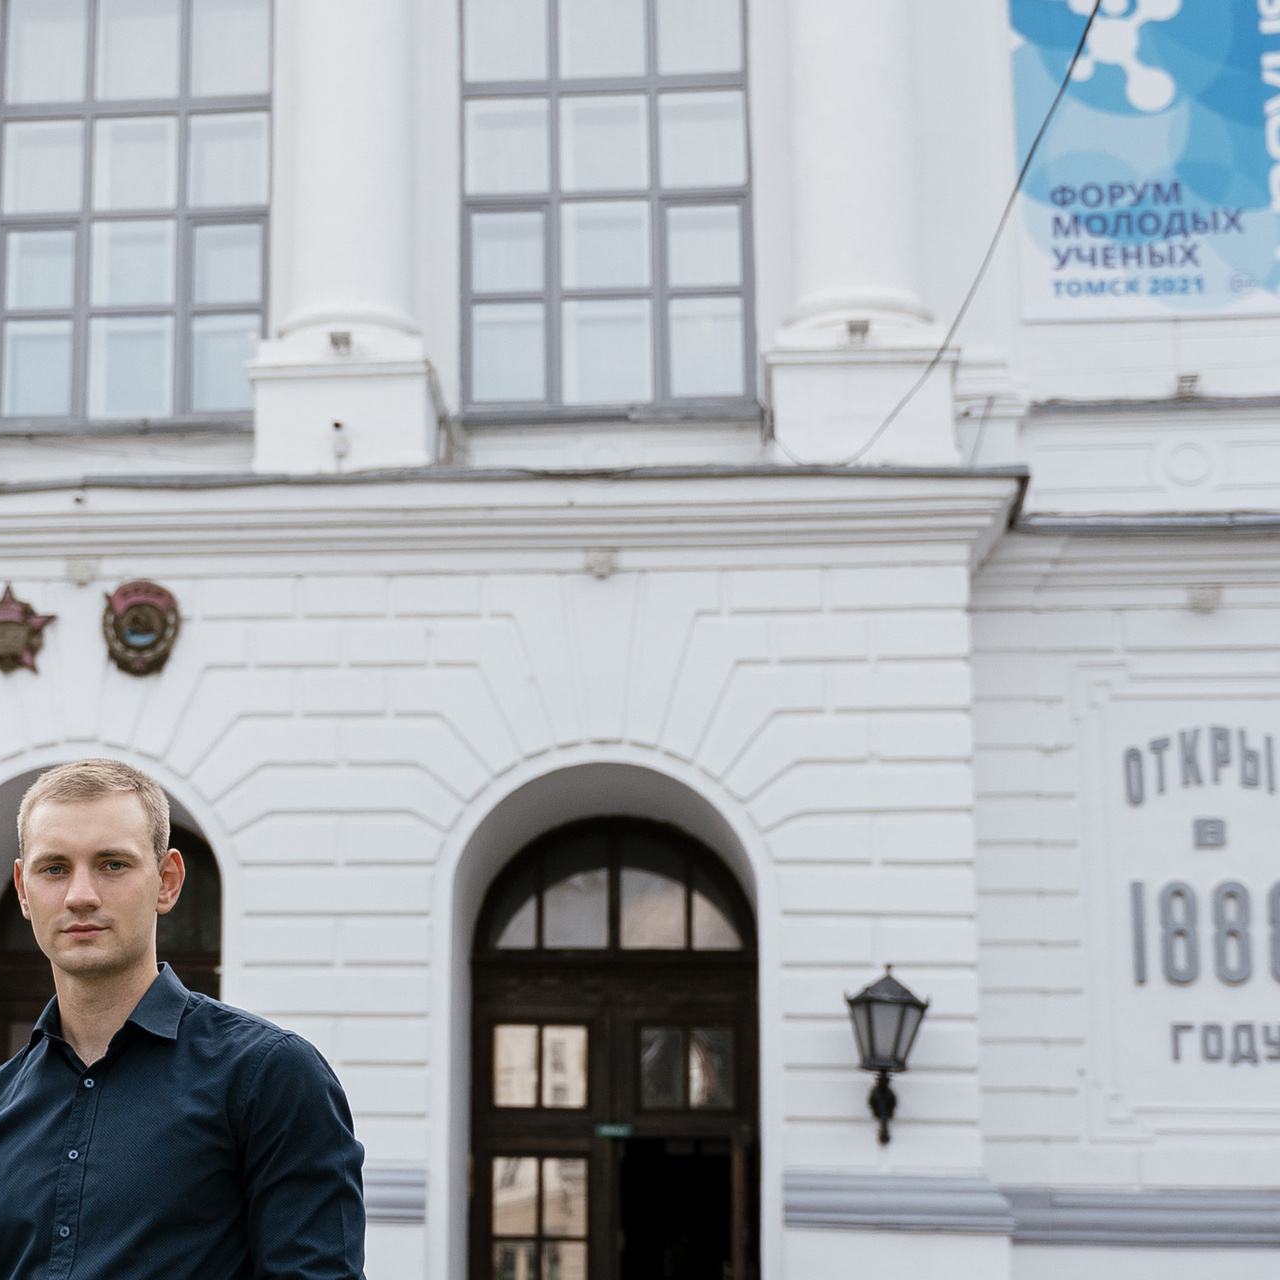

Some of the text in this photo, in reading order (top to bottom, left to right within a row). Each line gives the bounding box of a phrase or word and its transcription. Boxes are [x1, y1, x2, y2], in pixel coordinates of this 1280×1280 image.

[1050, 181, 1182, 208] ФОРУМ
[1052, 207, 1245, 239] МОЛОДЫХ
[1052, 243, 1200, 270] УЧЕНЫХ
[1053, 276, 1205, 297] ТОМСК 2021
[1124, 726, 1280, 806] ОТКРЫ
